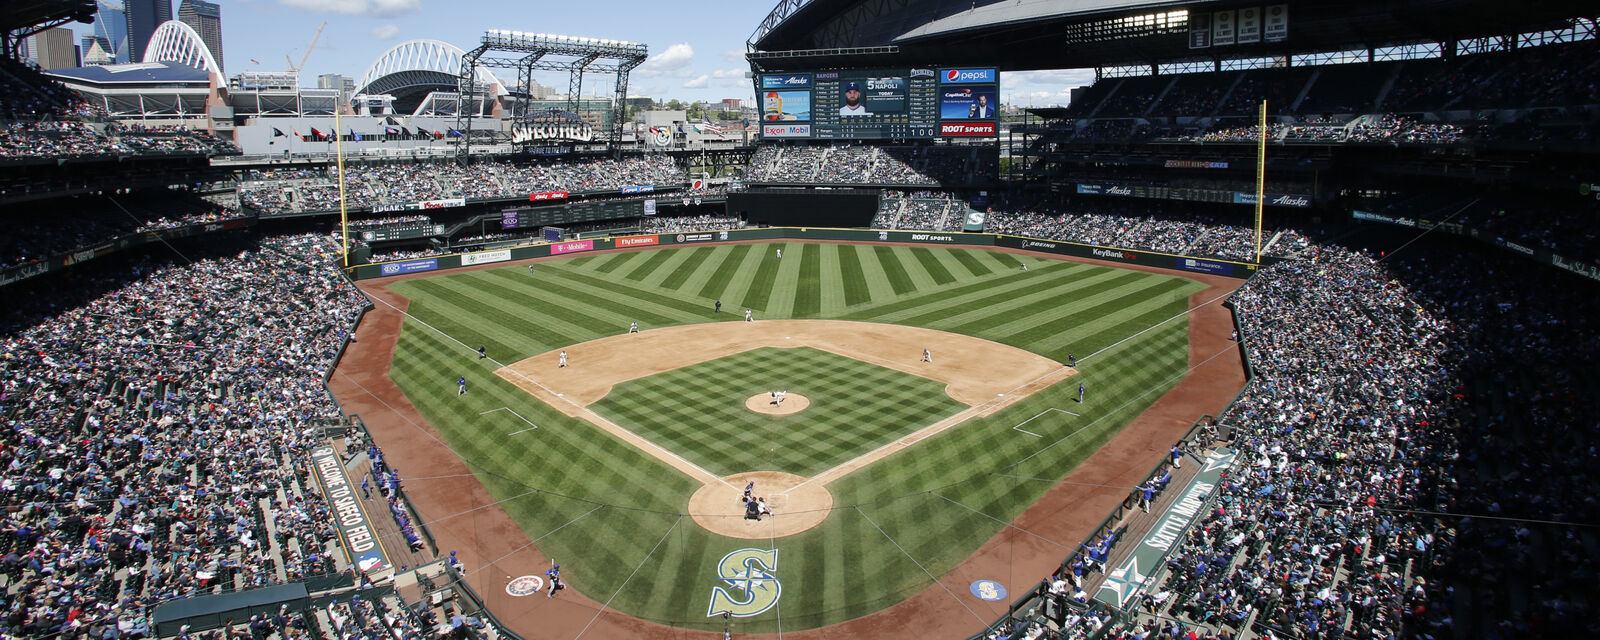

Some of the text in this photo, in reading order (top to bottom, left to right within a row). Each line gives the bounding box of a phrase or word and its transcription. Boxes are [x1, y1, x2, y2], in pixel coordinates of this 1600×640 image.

[910, 68, 934, 76] MARINERS
[961, 70, 987, 80] pepsi
[867, 81, 874, 90] 5
[512, 122, 592, 143] SAFECO FIELD
[1106, 186, 1131, 196] Alaska
[1273, 195, 1308, 207] Alaska
[1093, 248, 1123, 259] KeyBank
[317, 455, 375, 553] WELCOME TO SAFECO FIELD
[1145, 480, 1215, 551] SEATTLE MARINERS
[707, 548, 782, 617] S
